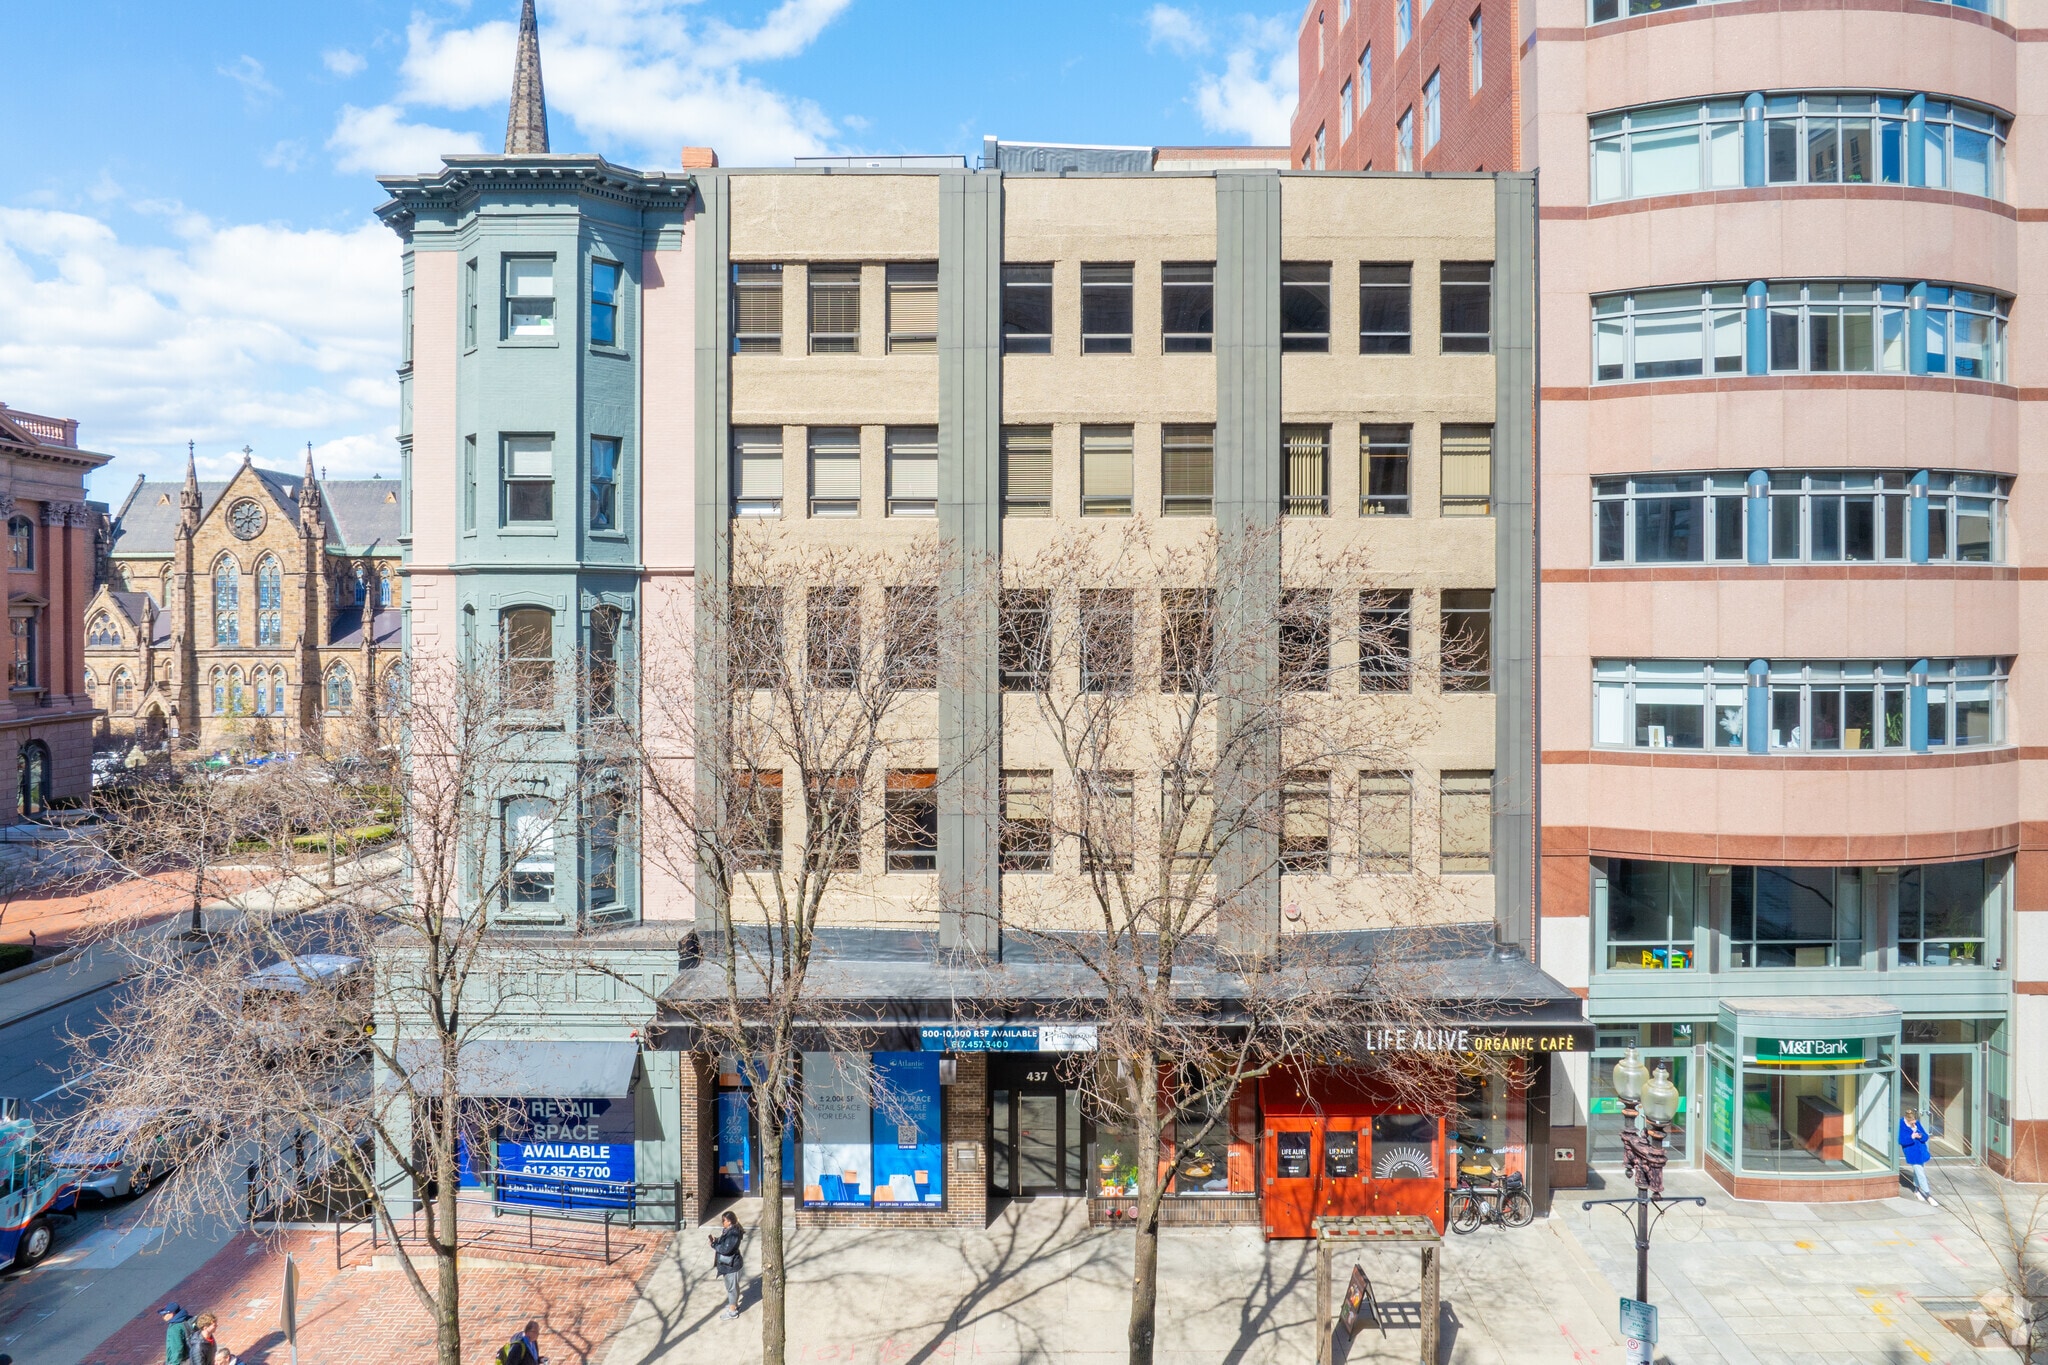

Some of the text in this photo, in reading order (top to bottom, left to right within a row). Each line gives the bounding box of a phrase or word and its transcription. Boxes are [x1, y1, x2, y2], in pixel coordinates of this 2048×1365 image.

[922, 1030, 1037, 1038] 800-10,000 RSF AVAILABLE
[1906, 1021, 1941, 1038] 425
[1366, 1029, 1407, 1050] LIFE
[1413, 1029, 1468, 1050] ALIVE
[1474, 1037, 1534, 1051] ORGANIC
[1778, 1039, 1849, 1055] M&T Bank
[897, 1059, 925, 1067] Atlantic
[1026, 1071, 1048, 1082] 437
[846, 1095, 855, 1103] SF
[907, 1095, 931, 1103] SPACE
[532, 1101, 601, 1118] RETAIL
[818, 1112, 856, 1120] FOR LEASE
[533, 1123, 600, 1141] SPACE
[523, 1145, 610, 1158] AVAILABLE
[562, 1184, 606, 1195] Company,
[608, 1185, 628, 1194] Ltd.
[1105, 1187, 1123, 1196] FDC
